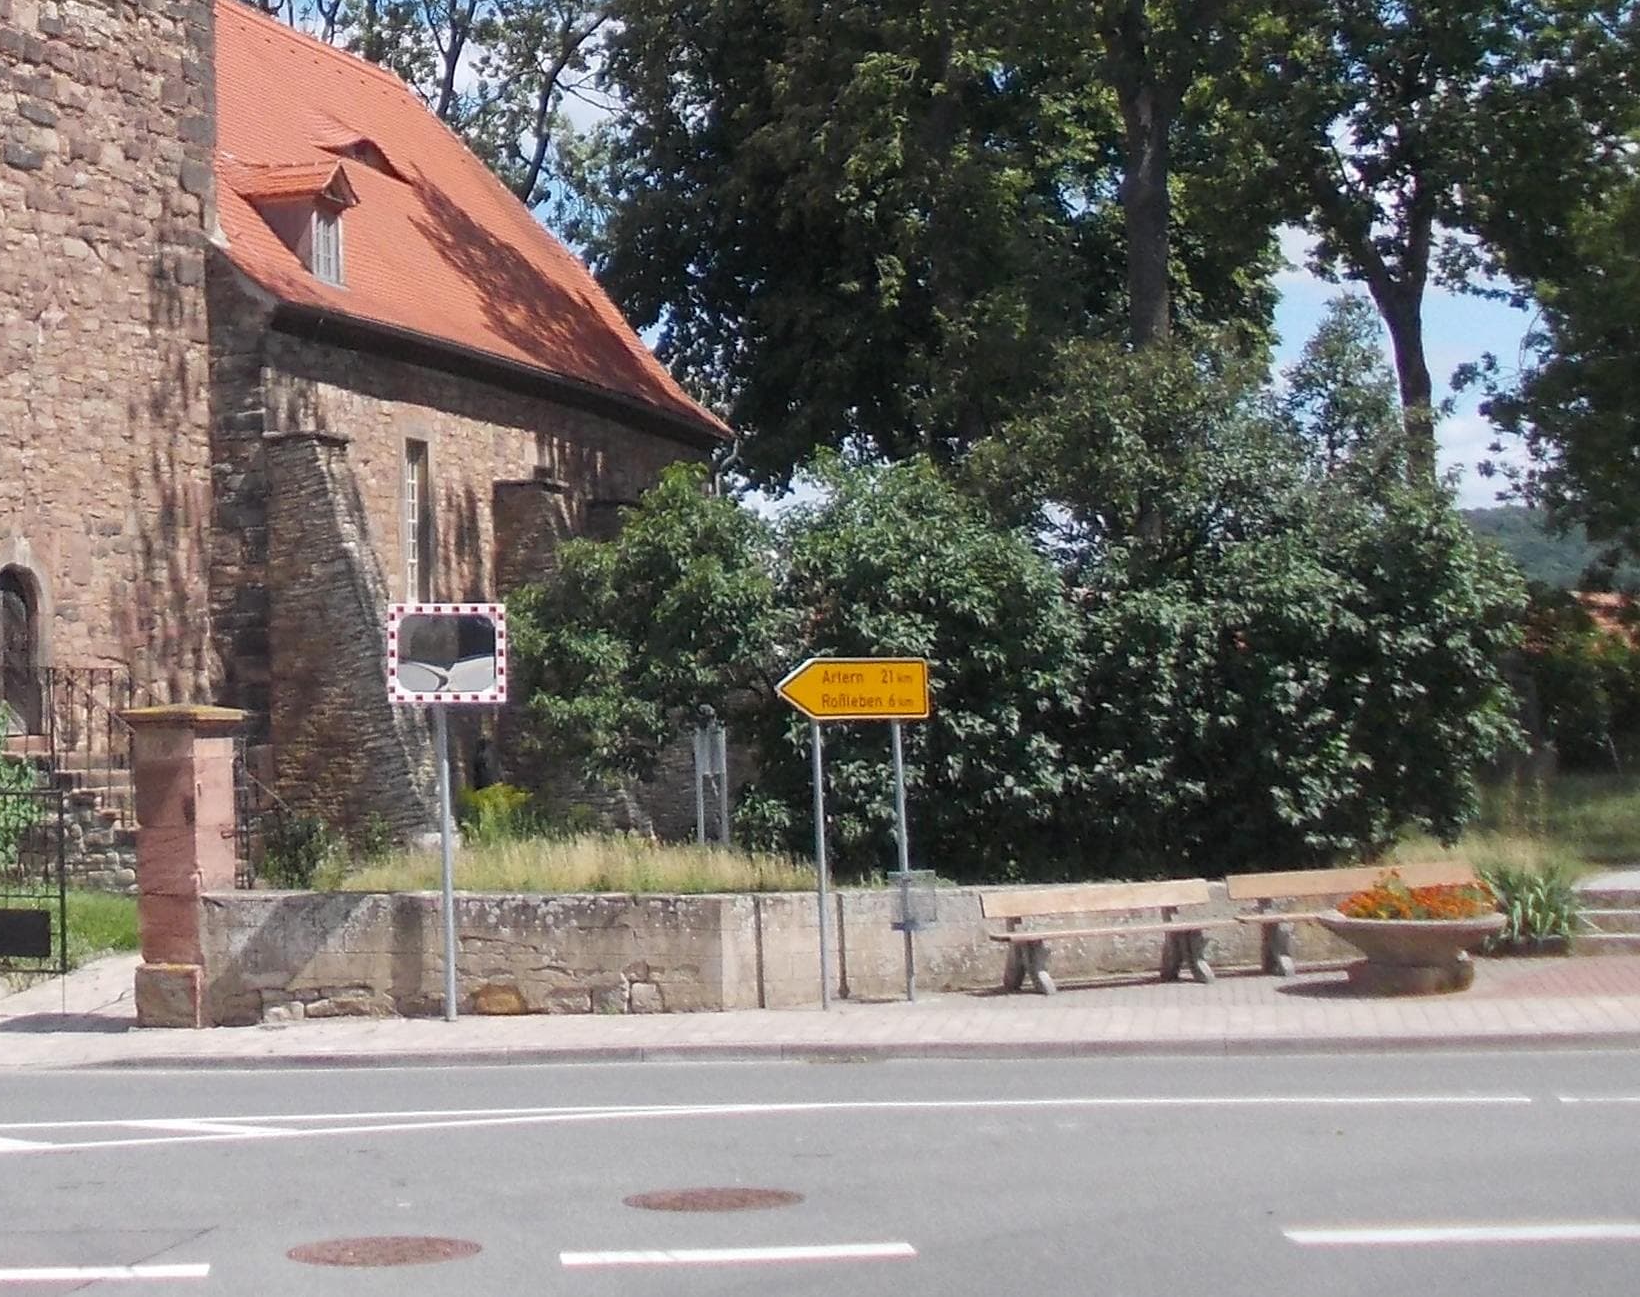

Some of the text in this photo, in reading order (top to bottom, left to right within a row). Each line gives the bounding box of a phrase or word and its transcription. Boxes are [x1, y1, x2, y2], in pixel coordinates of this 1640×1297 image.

[822, 670, 864, 684] Artern
[881, 670, 894, 684] 21
[822, 693, 882, 708] Roßleben
[888, 694, 896, 707] 6
